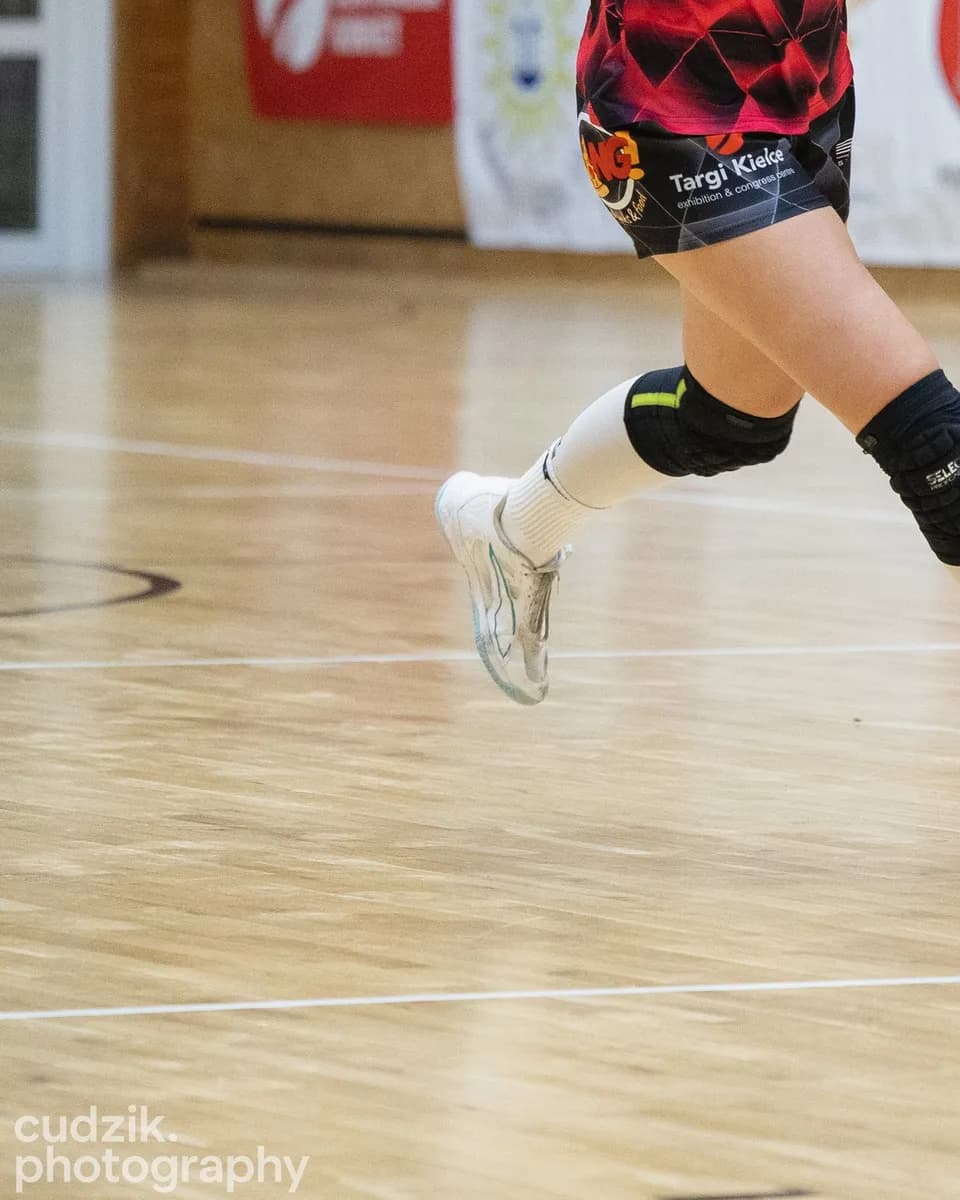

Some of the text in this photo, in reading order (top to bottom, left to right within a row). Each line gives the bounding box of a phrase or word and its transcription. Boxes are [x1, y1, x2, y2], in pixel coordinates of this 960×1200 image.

[669, 163, 729, 193] Targi
[731, 148, 785, 177] Kielce
[677, 191, 723, 210] exhibition
[724, 188, 734, 198] &
[735, 173, 777, 194] congress
